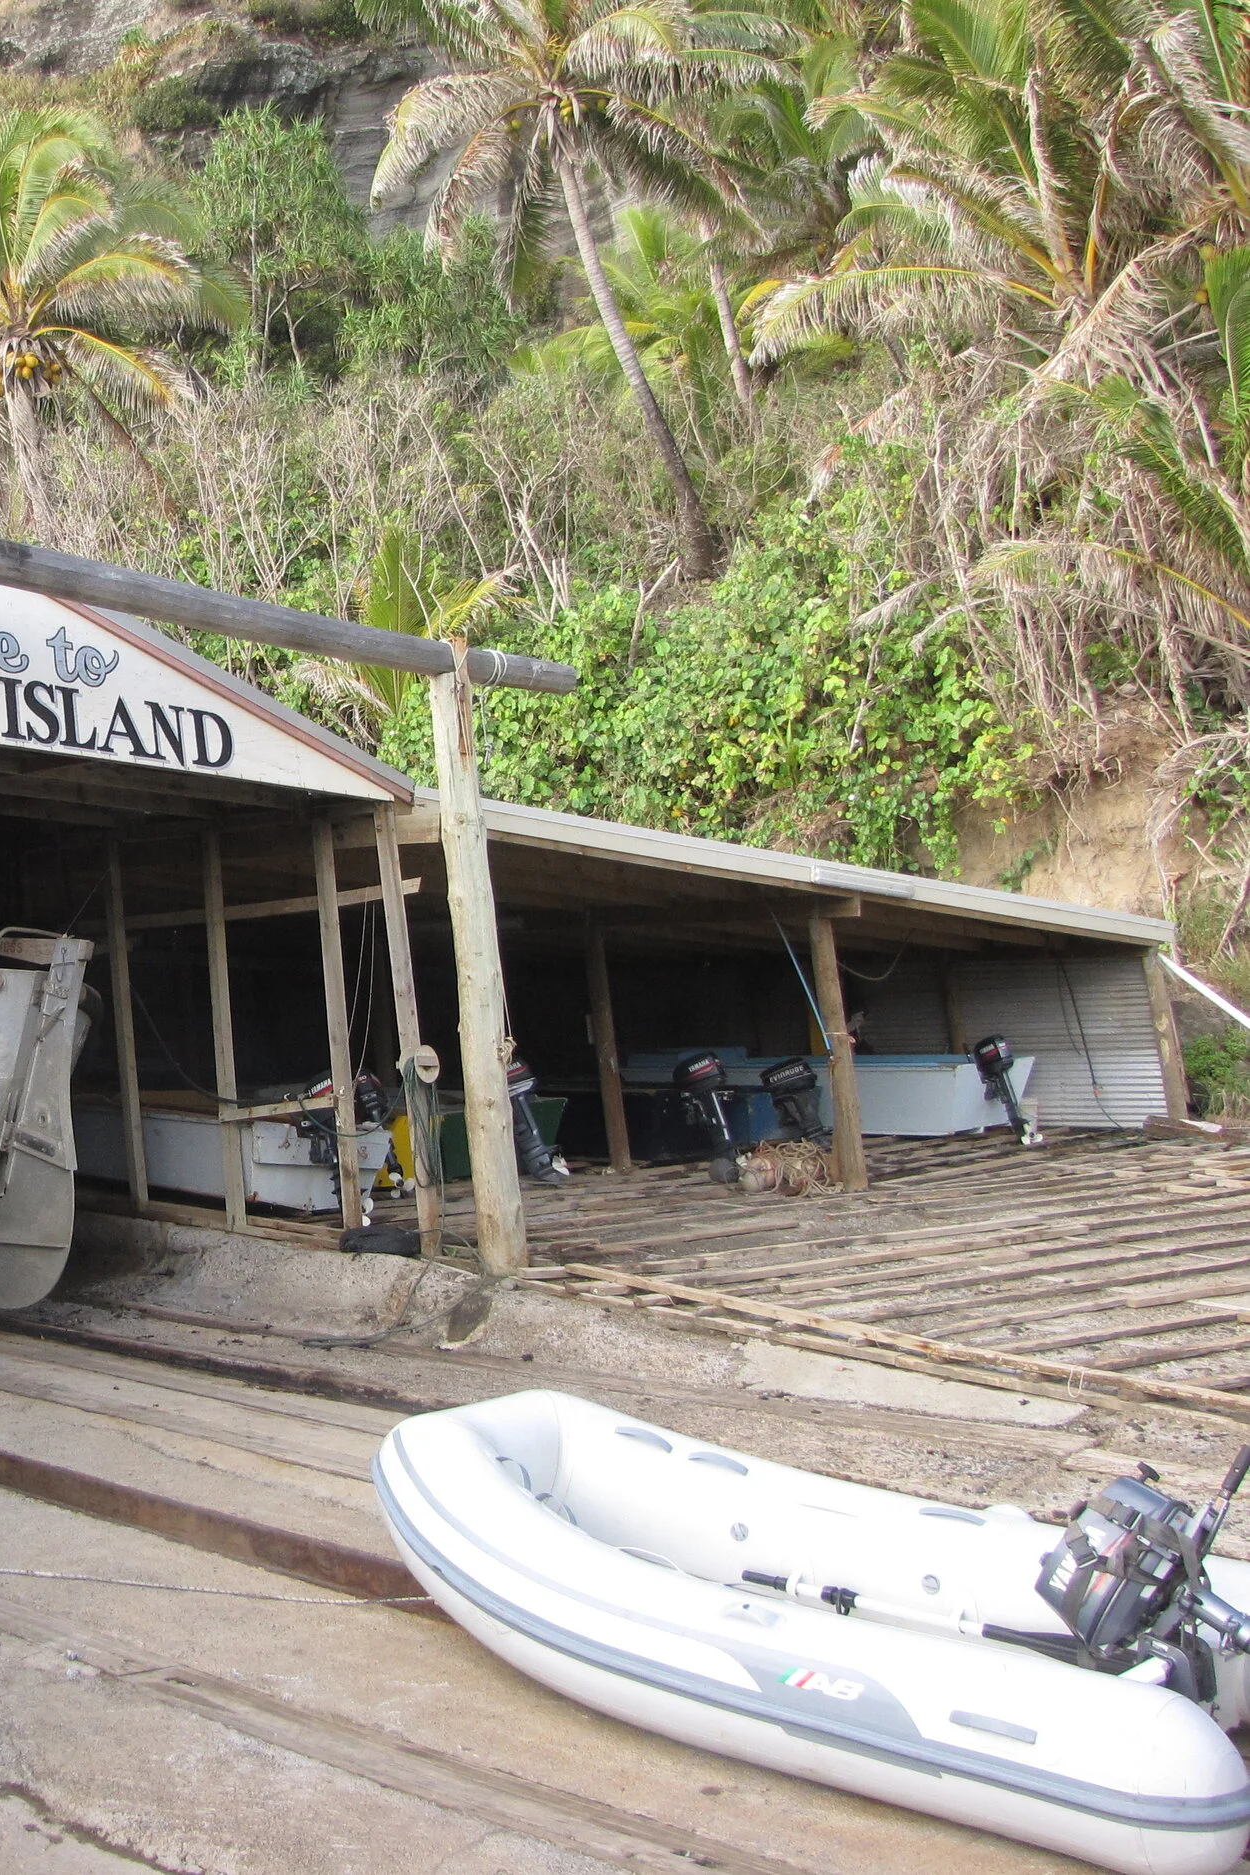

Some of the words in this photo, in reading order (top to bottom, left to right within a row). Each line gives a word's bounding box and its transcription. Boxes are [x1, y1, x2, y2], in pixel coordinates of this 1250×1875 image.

[46, 626, 120, 687] to
[688, 1058, 710, 1073] YAMAHA
[769, 1064, 805, 1084] EVINRUDE
[310, 1077, 332, 1095] YAMAHA
[1049, 1525, 1107, 1592] YAMA
[802, 1672, 865, 1701] AB
